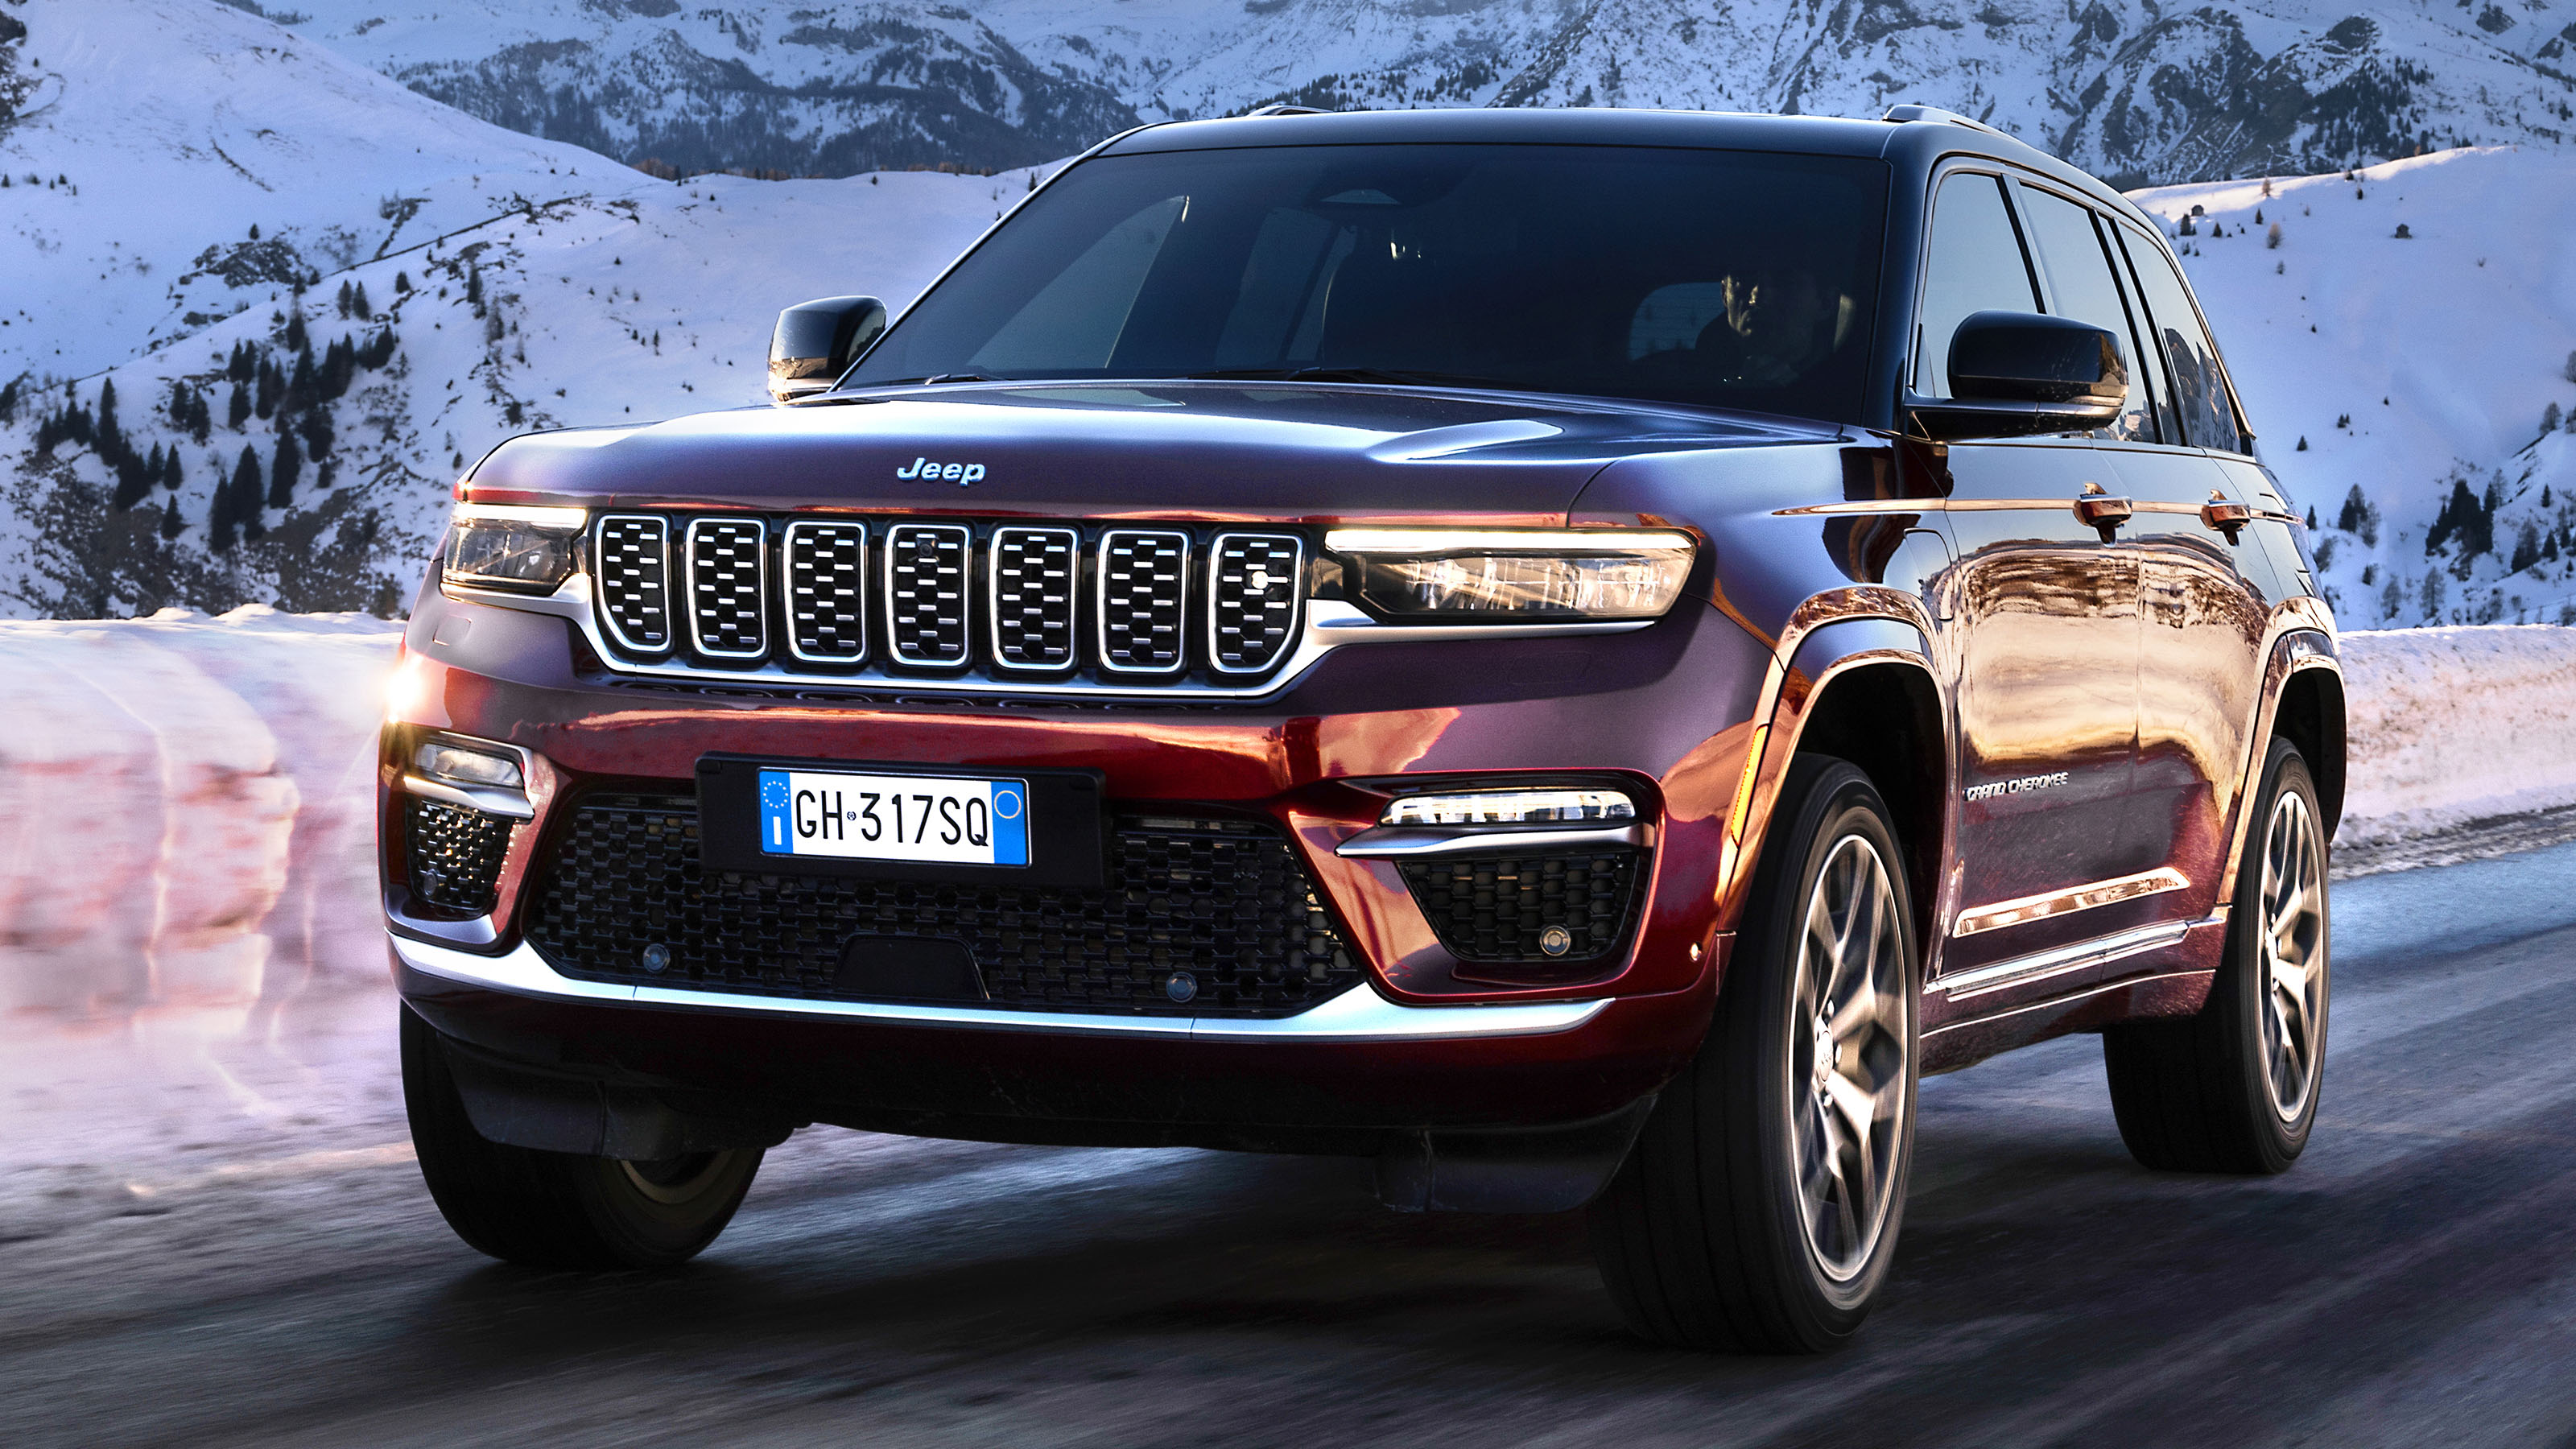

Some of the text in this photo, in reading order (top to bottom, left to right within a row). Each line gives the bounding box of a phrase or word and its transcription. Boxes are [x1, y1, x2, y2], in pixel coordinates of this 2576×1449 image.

[897, 457, 986, 486] Jeep
[1966, 771, 2069, 802] GRAND CHEROKEE
[773, 816, 782, 844] I
